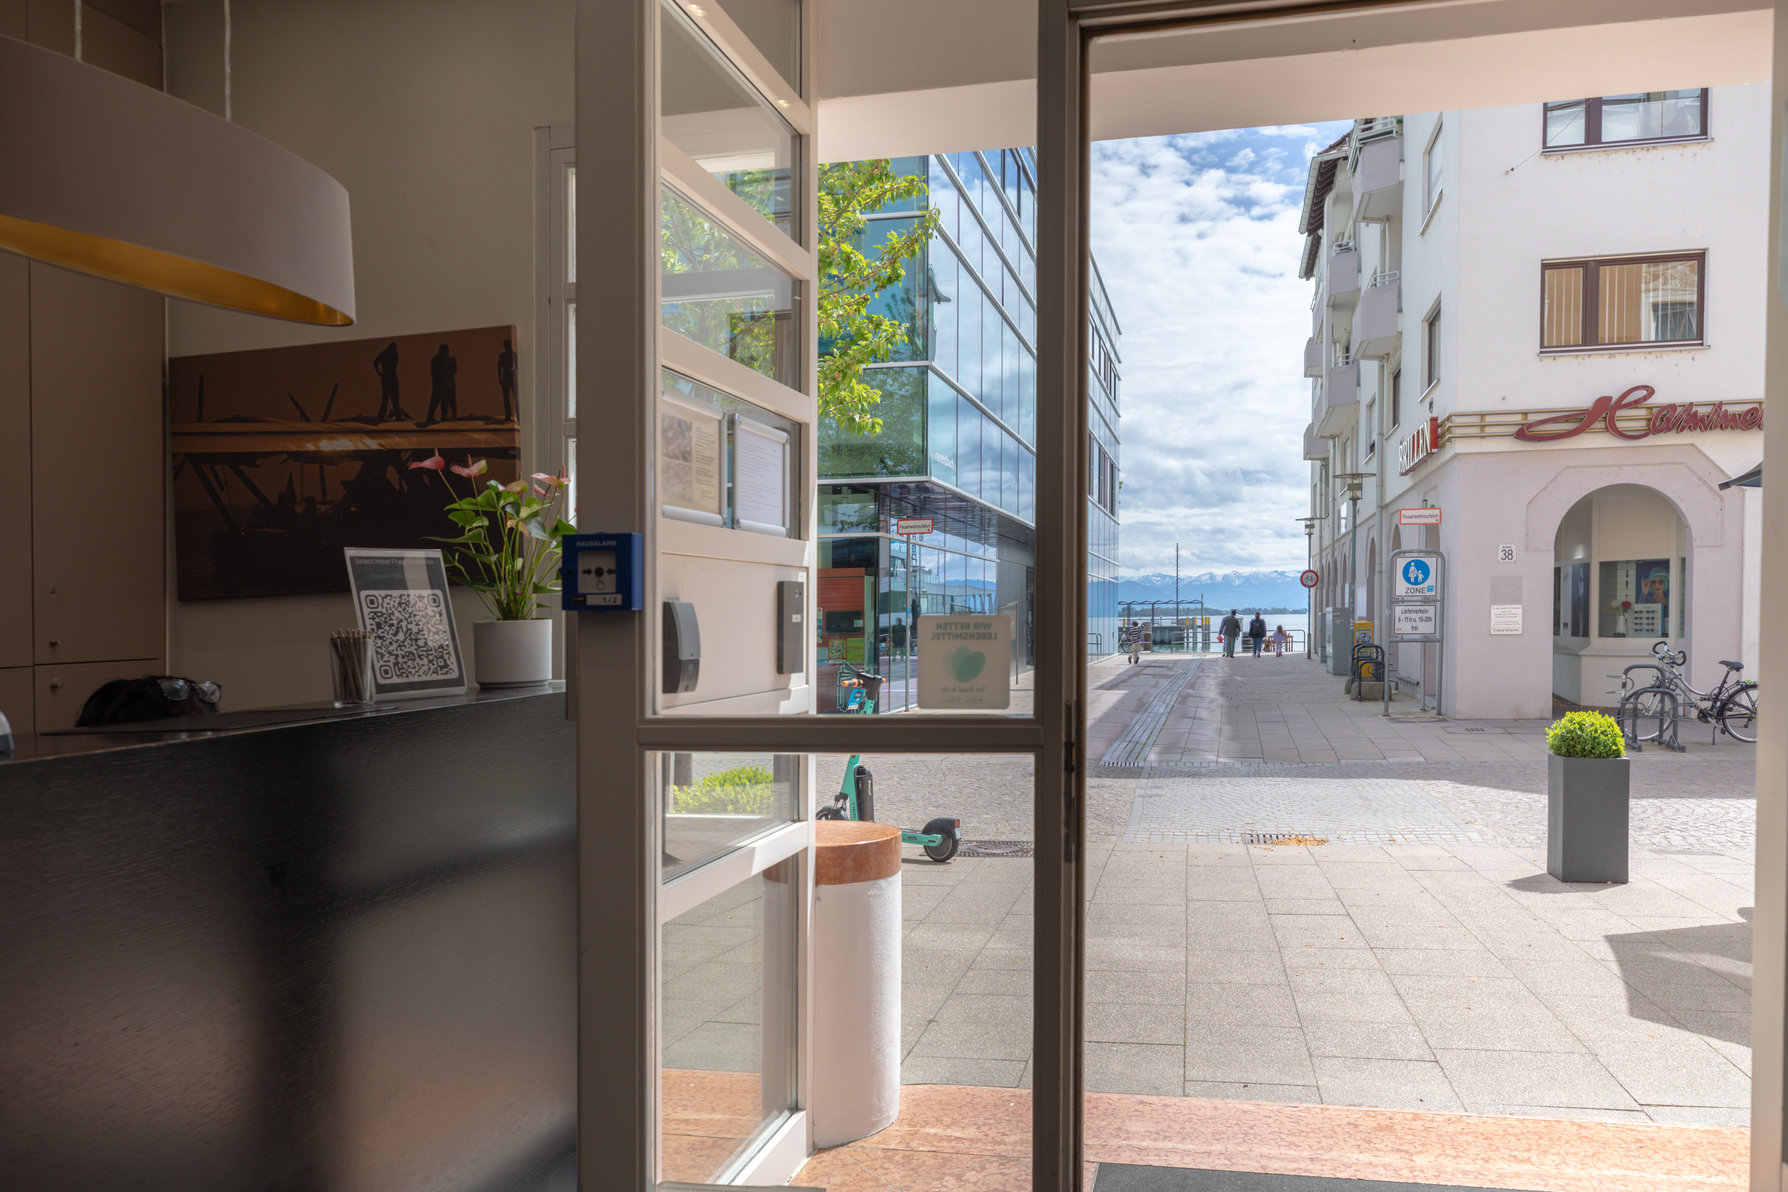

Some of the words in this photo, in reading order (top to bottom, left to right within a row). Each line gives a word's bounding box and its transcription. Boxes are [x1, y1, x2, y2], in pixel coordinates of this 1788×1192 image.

[1513, 384, 1764, 442] Hamme
[1399, 418, 1432, 473] BRILLEN
[1500, 548, 1514, 561] 38
